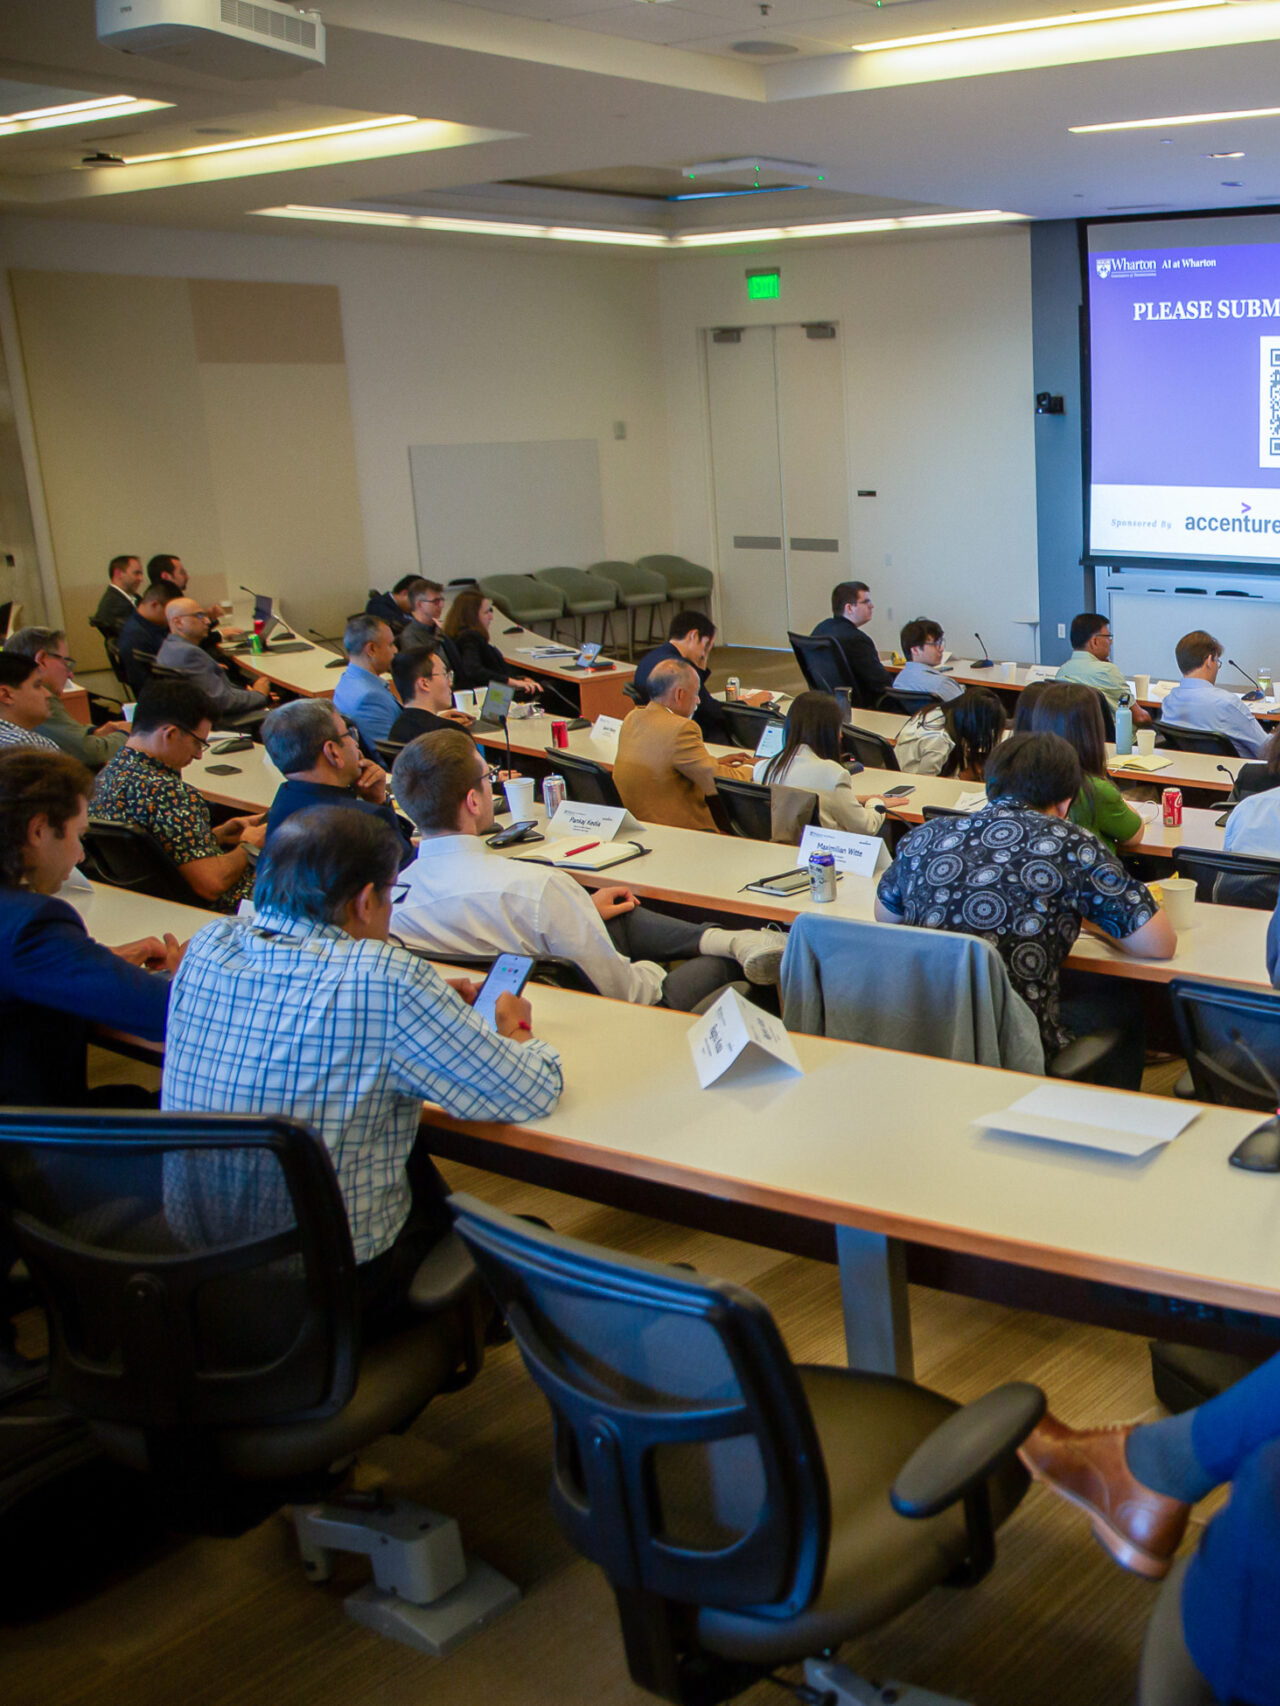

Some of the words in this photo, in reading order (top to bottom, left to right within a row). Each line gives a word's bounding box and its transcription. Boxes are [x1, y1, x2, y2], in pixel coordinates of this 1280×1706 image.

[1111, 257, 1156, 271] Wharton
[1162, 260, 1171, 269] AI
[1173, 260, 1180, 268] at
[1182, 258, 1216, 268] Wharton
[1133, 301, 1213, 321] PLEASE
[1111, 519, 1157, 528] Sponsored
[1161, 521, 1172, 529] By
[817, 842, 847, 854] Maximilian
